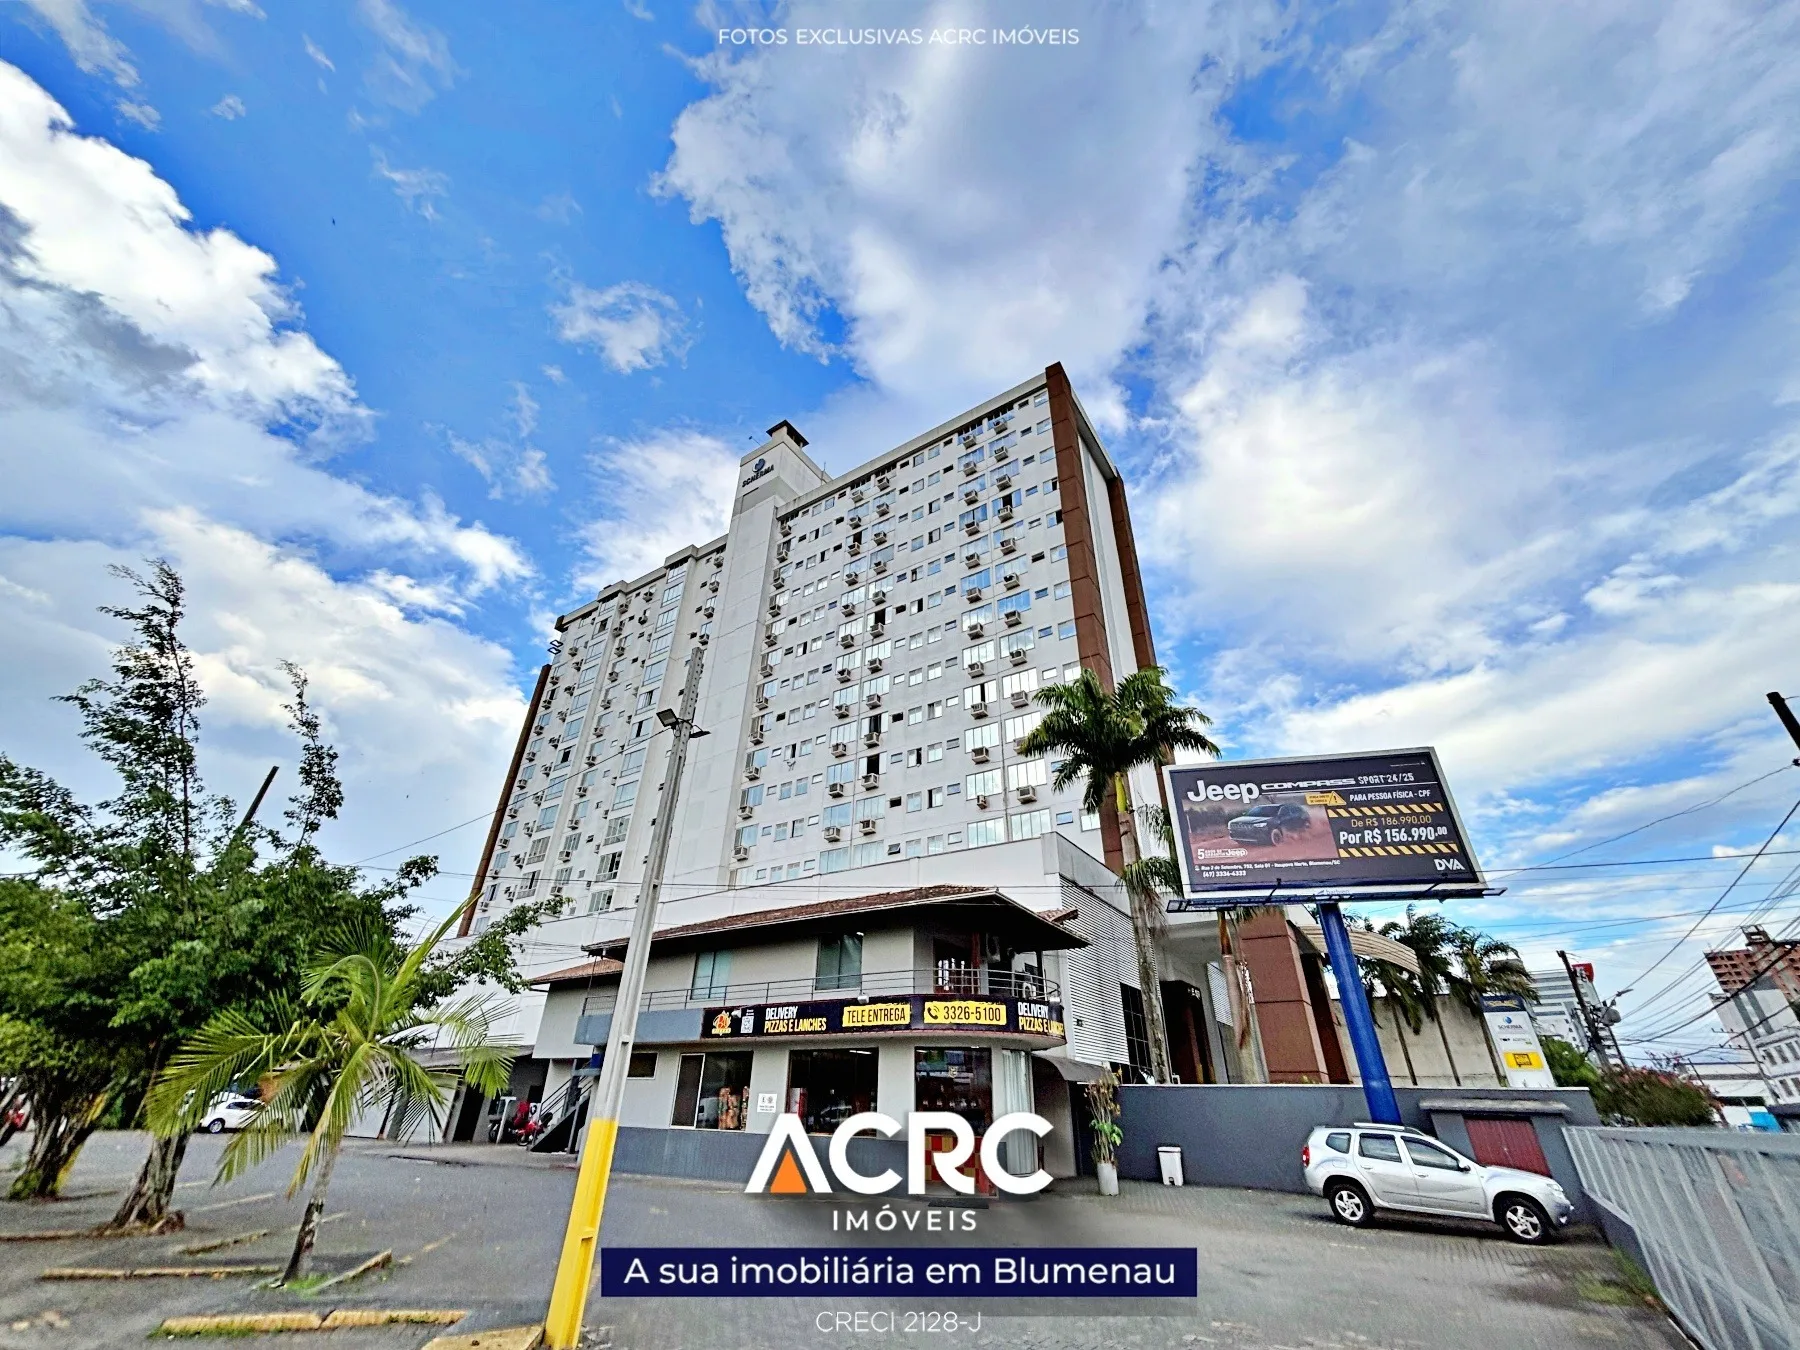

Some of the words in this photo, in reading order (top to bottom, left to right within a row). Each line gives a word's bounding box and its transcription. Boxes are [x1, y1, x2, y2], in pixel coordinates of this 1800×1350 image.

[1187, 780, 1260, 804] Jeep
[1261, 778, 1356, 790] COMPASS
[1357, 775, 1385, 785] SPORT
[1385, 772, 1415, 783] 24/25
[1350, 793, 1367, 801] PARA
[1368, 792, 1393, 800] PESSOA
[1393, 789, 1414, 799] FÍSICA
[1418, 789, 1431, 798] CPF
[1351, 819, 1364, 828] De
[1365, 817, 1378, 827] R$
[1339, 831, 1361, 844] Por
[1364, 828, 1382, 844] R$
[1197, 848, 1205, 860] 5
[1434, 859, 1466, 871] DVA
[765, 1006, 798, 1020] DELIVERY
[847, 1009, 865, 1024] TELE
[867, 1007, 906, 1022] ENTREGA
[943, 1005, 1001, 1022] 3326-5100
[1017, 1001, 1049, 1019] DELIVERY
[764, 1019, 788, 1033] PIZZAS
[788, 1019, 794, 1032] E
[794, 1017, 827, 1032] LANCHES
[1018, 1016, 1044, 1032] PIZZAS
[1043, 1018, 1048, 1033] E
